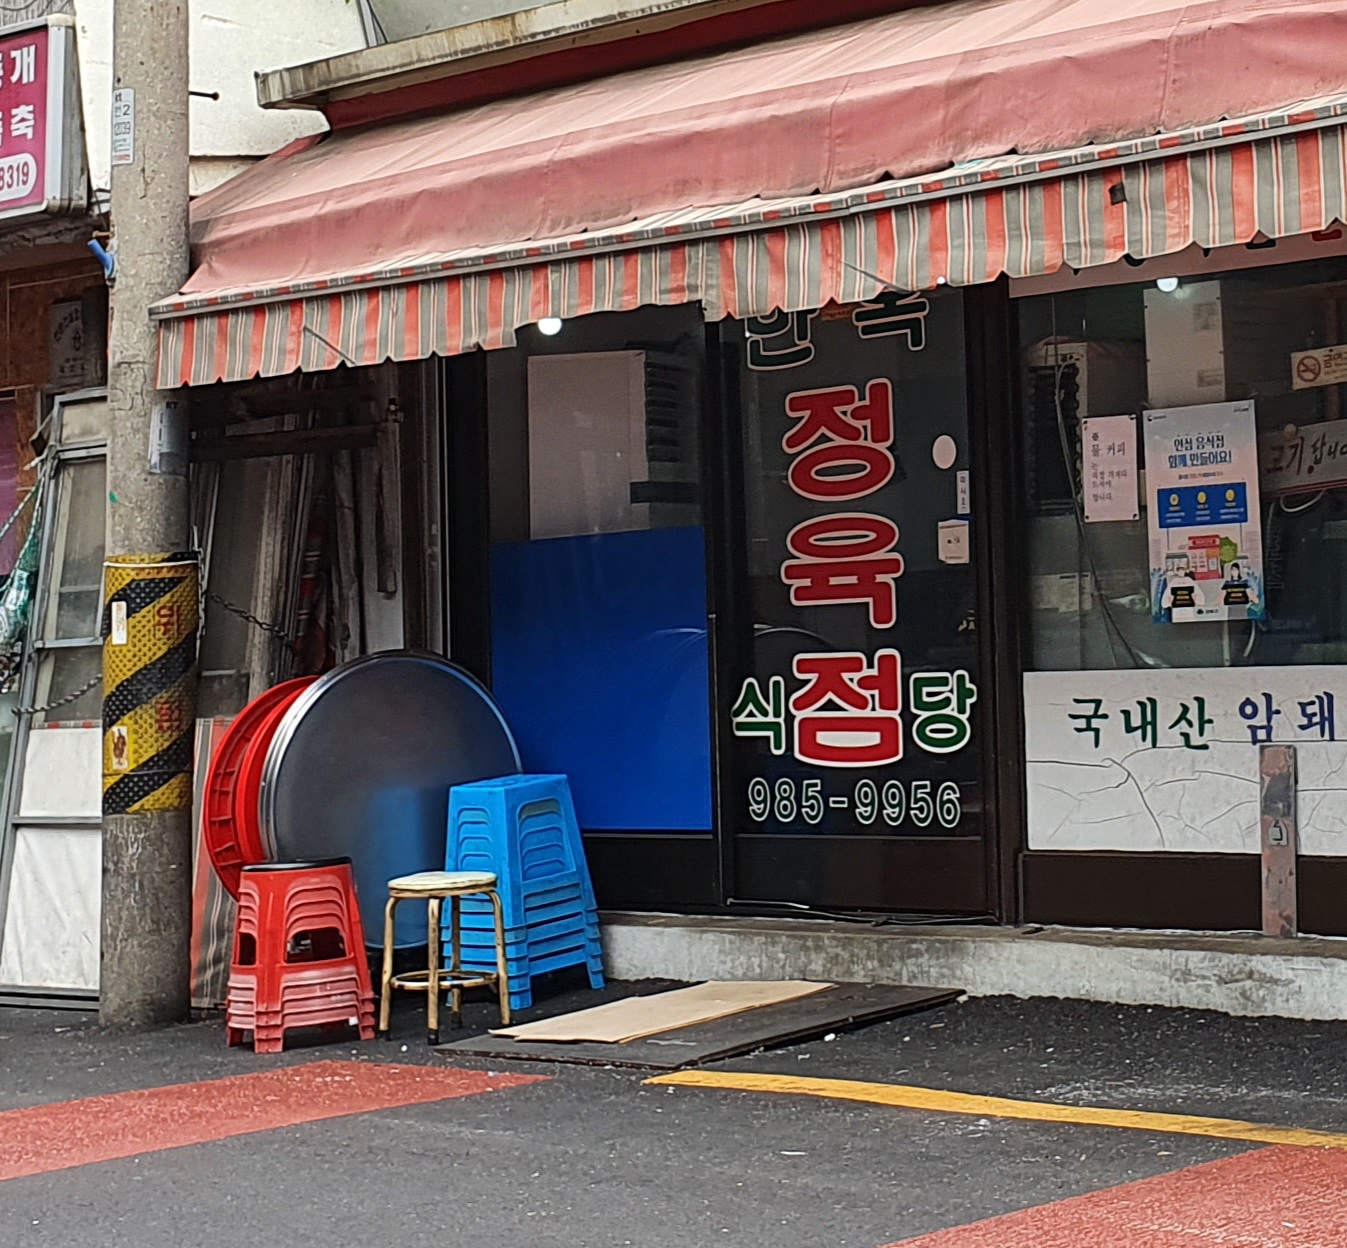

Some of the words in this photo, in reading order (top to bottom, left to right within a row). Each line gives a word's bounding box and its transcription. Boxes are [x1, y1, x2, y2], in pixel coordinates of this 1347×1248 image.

[780, 377, 905, 768] 정육점
[1067, 696, 1214, 750] 국내산
[748, 777, 961, 829] 985-9956
